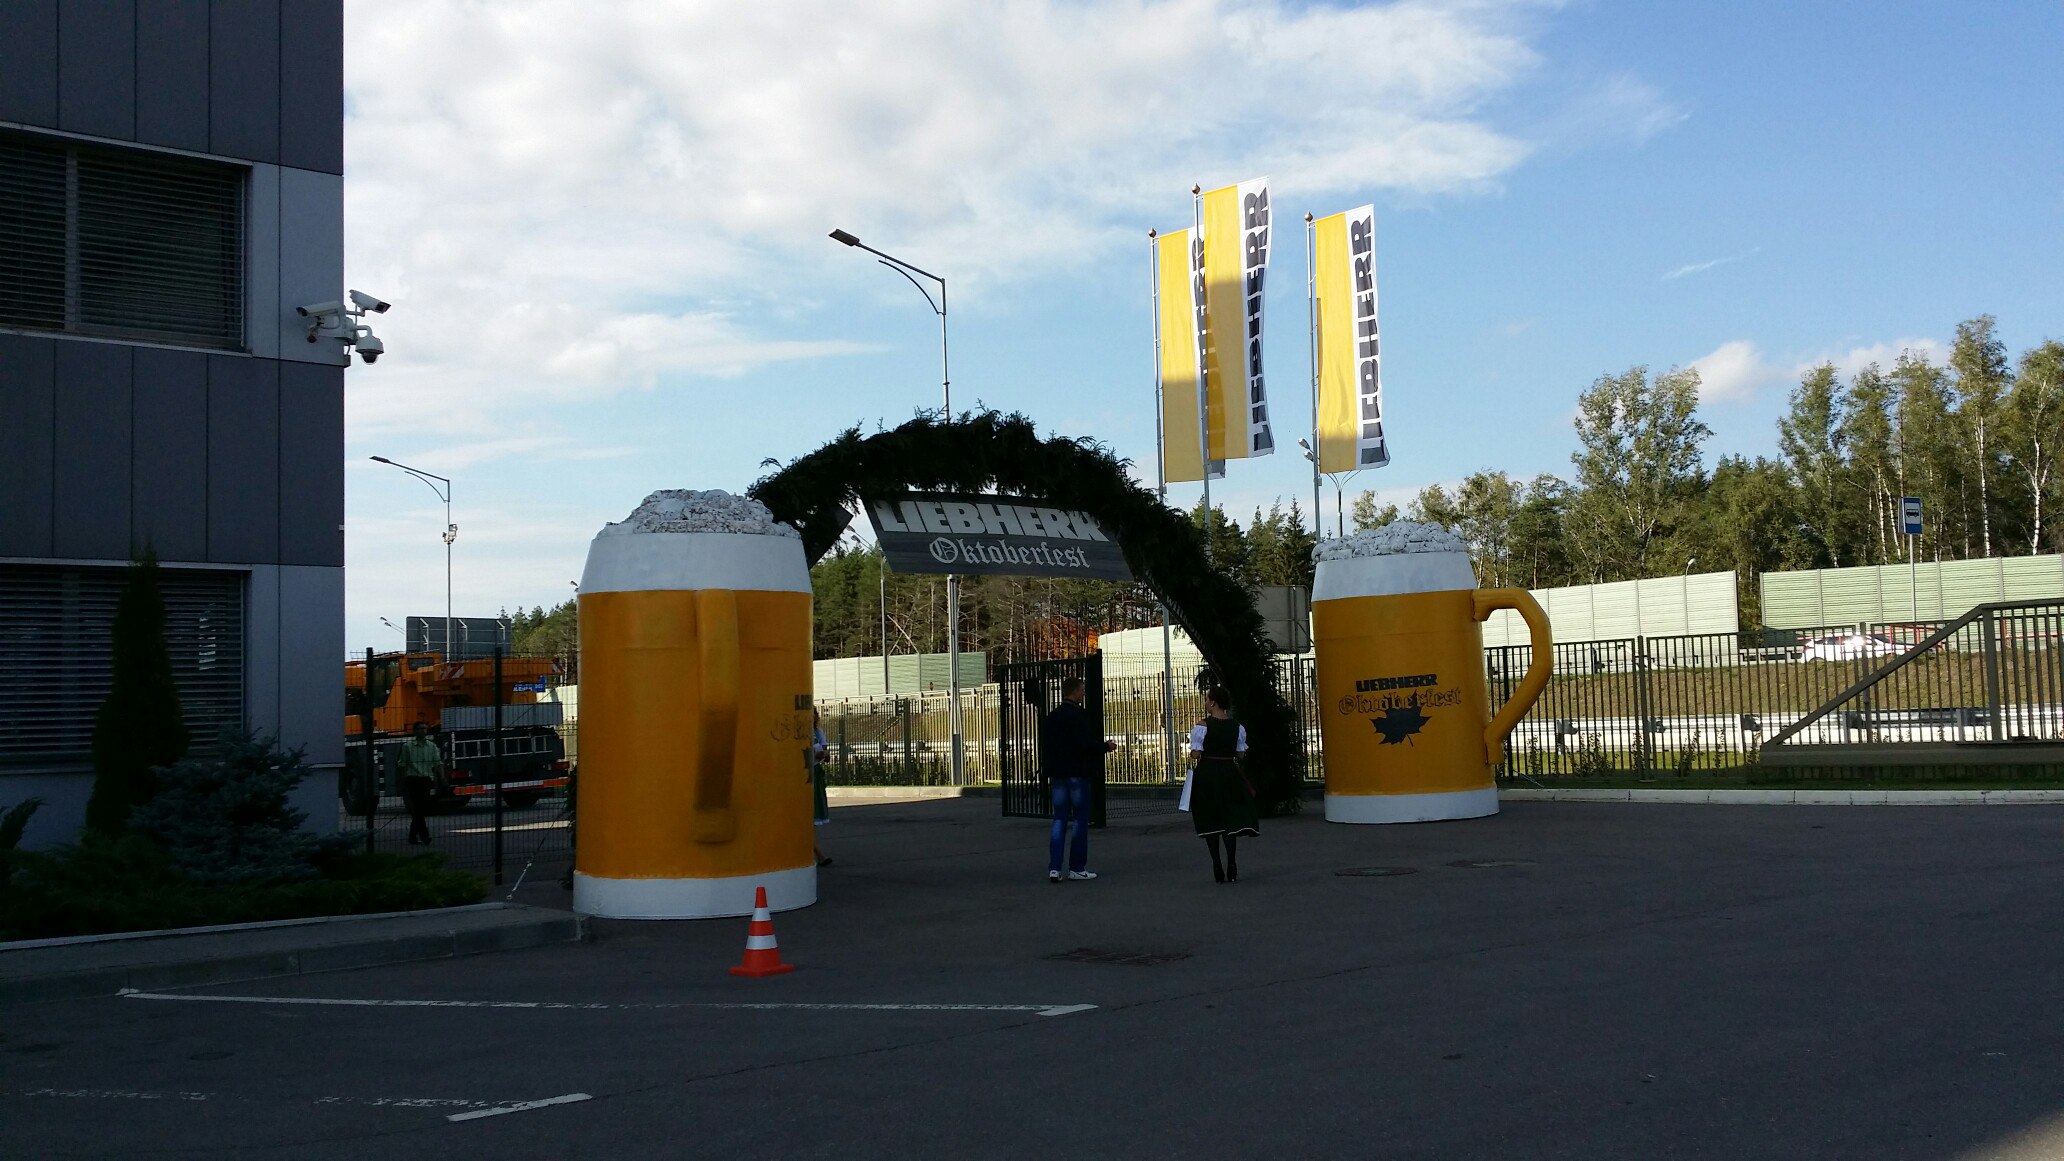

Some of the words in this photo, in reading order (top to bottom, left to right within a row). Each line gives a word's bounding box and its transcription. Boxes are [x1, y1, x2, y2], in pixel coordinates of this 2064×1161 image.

[1244, 186, 1275, 452] LIEBHERR
[1351, 214, 1389, 465] LIEBHERR
[873, 500, 1110, 542] LIEBHERR
[929, 536, 1090, 569] Oktoberfest
[1338, 686, 1462, 716] Oktoberfest
[1356, 674, 1438, 692] LIEBHERR
